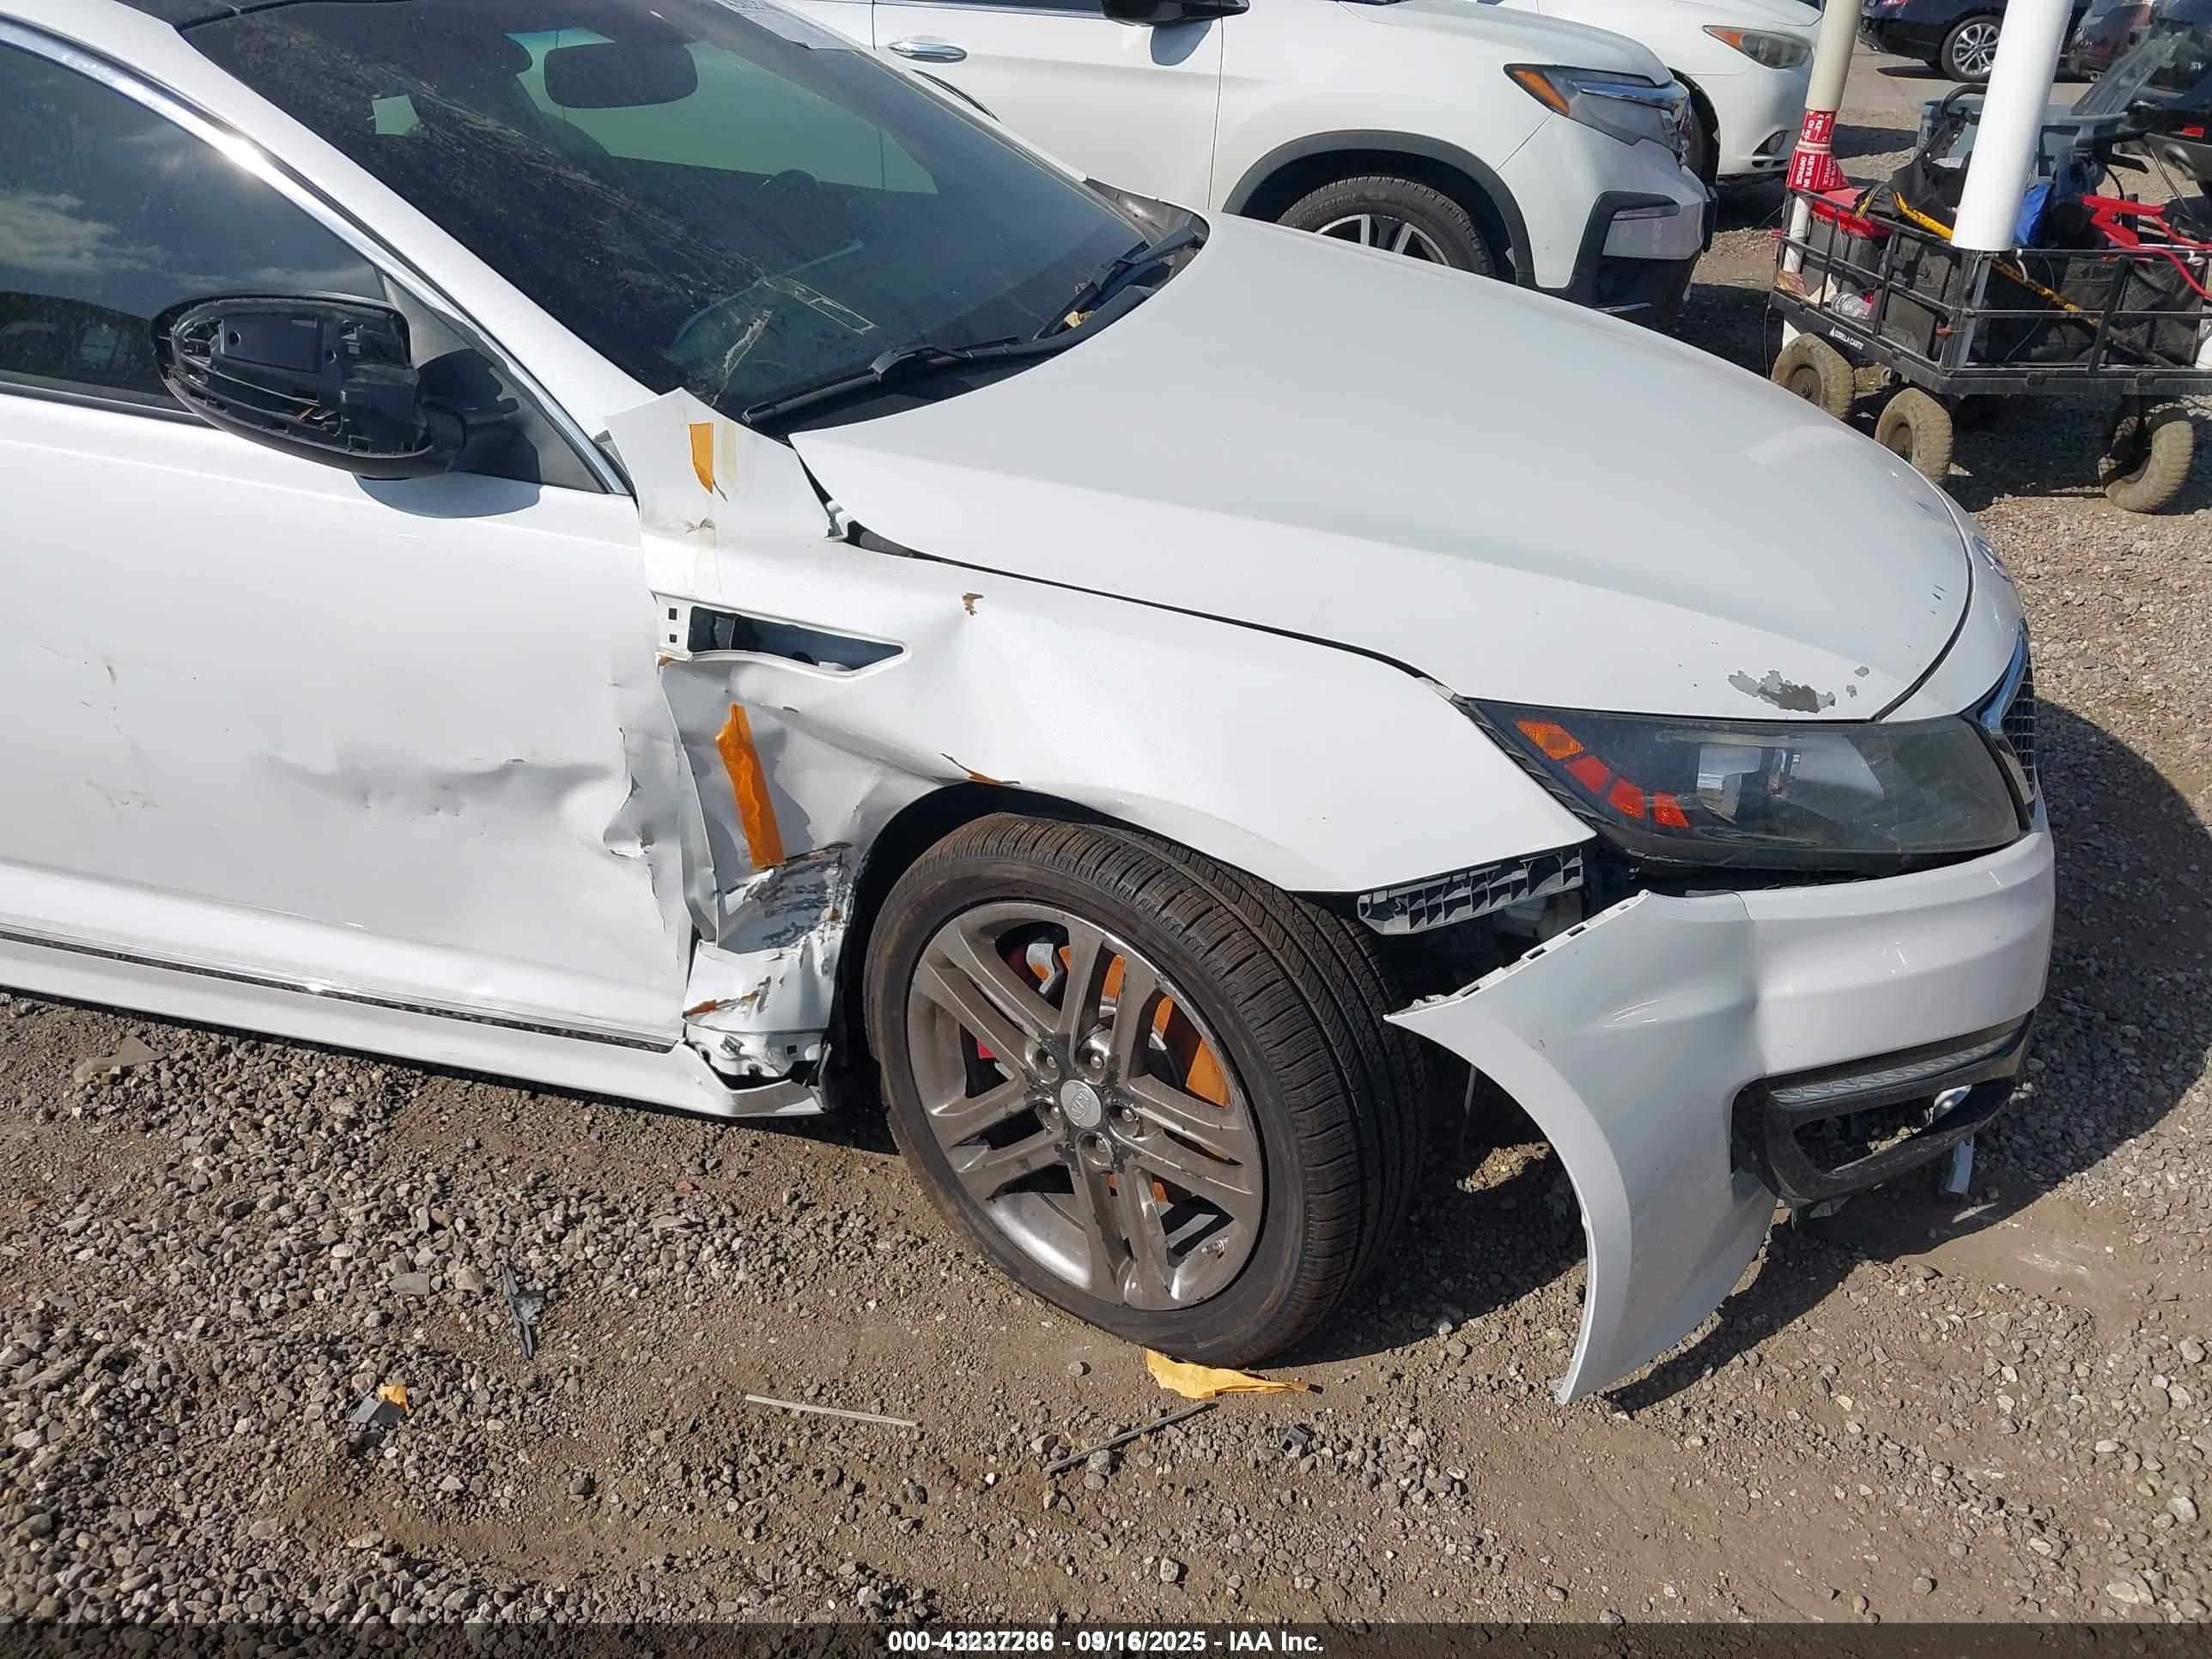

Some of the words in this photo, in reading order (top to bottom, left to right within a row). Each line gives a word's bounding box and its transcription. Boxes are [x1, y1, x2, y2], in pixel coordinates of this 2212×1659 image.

[1796, 156, 1807, 185] OFFICE
[1806, 155, 1815, 177] KEYS
[1822, 157, 1832, 185] OFFICE
[1803, 179, 1811, 188] IN
